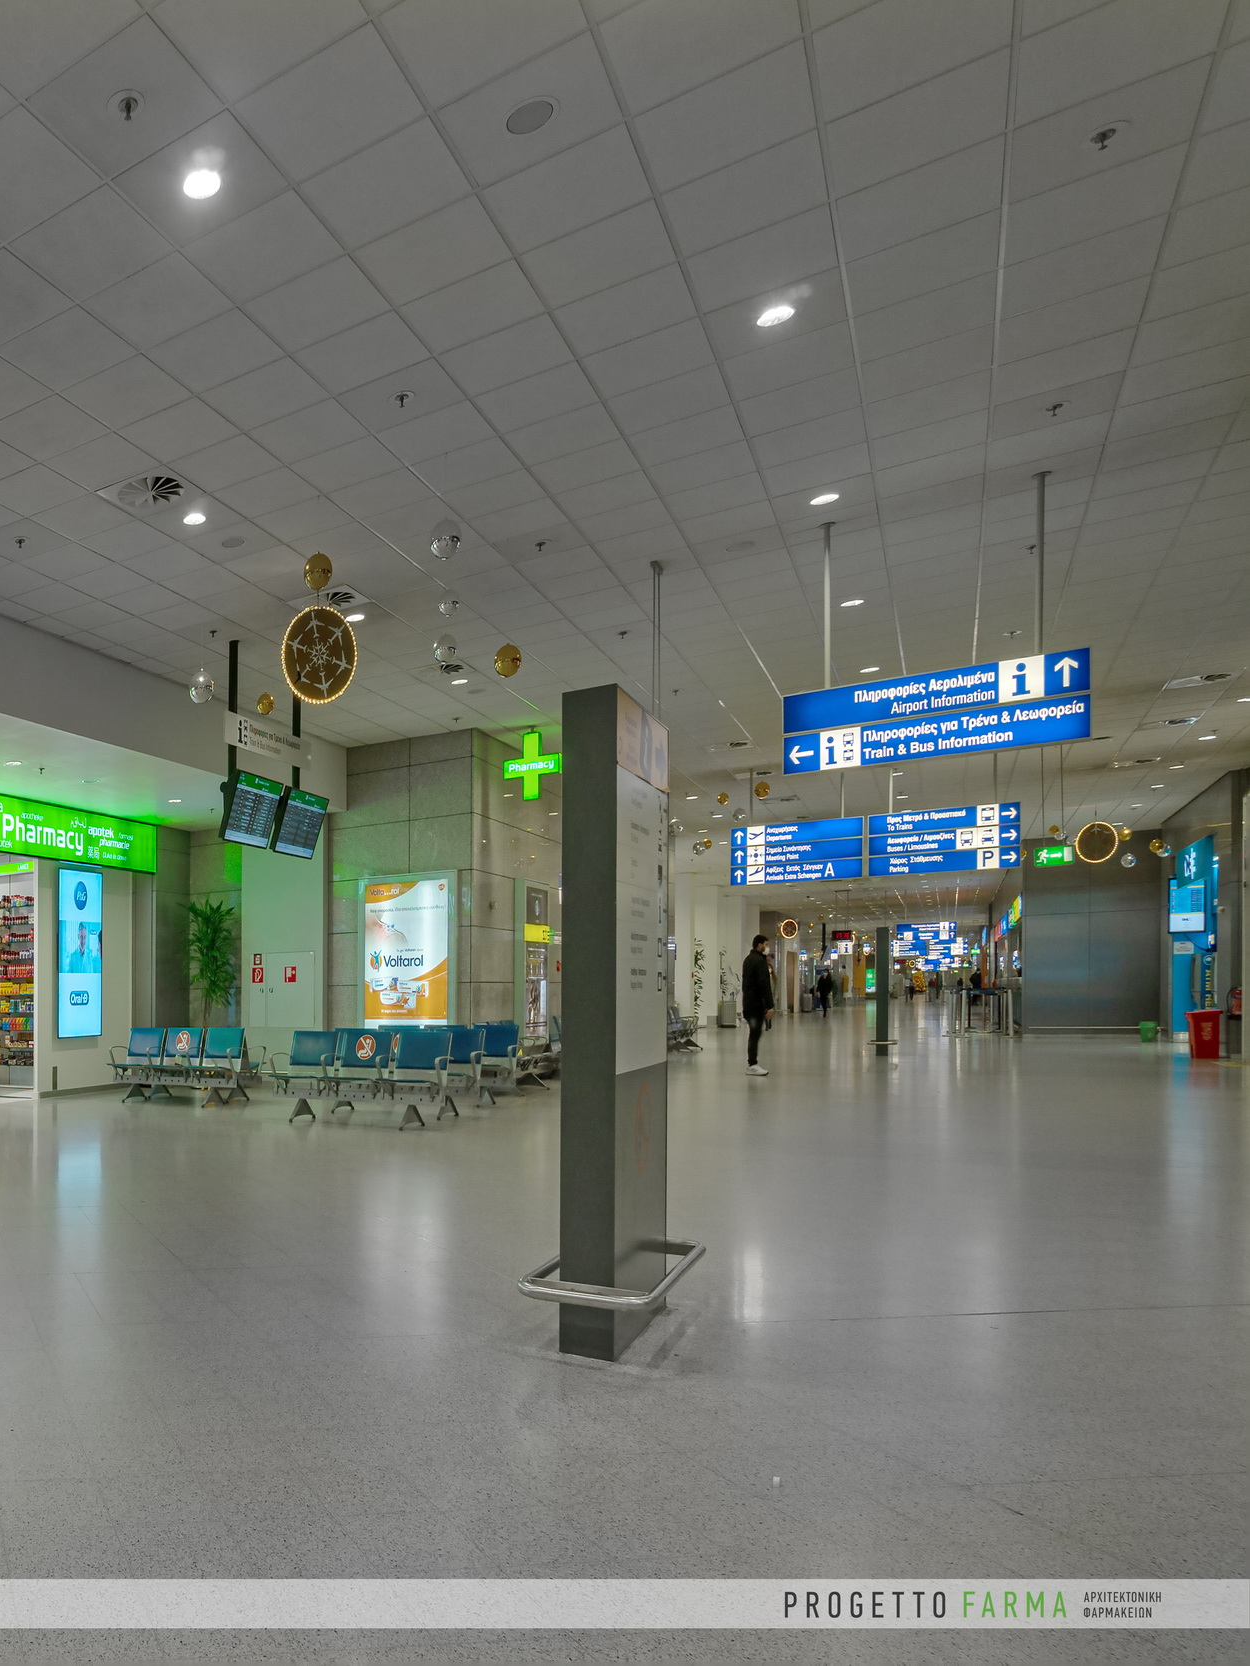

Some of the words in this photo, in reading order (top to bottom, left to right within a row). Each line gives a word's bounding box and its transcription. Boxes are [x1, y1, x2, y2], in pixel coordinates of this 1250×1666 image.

[854, 681, 926, 704] Πληροφορίες
[928, 671, 996, 692] Αερολιμένα
[891, 697, 928, 715] Airport
[930, 689, 996, 709] Information
[863, 725, 938, 745] Πληροφορίες
[940, 719, 959, 736] για
[961, 713, 999, 732] Τρένα
[1001, 711, 1011, 723] &
[1013, 700, 1085, 722] Λεωφορεία
[863, 745, 895, 760] Train
[898, 743, 907, 756] &
[910, 739, 935, 754] Bus
[937, 730, 1014, 750] Information
[508, 760, 554, 773] Pharmacy
[21, 812, 44, 821] apotheke
[887, 816, 903, 825] Προς
[903, 814, 922, 823] Μετρό
[930, 809, 966, 820] Προαστιακό
[88, 826, 114, 838] apotek
[766, 825, 799, 834] Αναχωρήσεις
[895, 823, 913, 831] Trains
[2, 813, 84, 856] Pharmacy
[766, 834, 793, 842] Departures
[887, 836, 919, 845] Λεωφορεία
[923, 832, 955, 841] Λιμουζίνες
[99, 838, 130, 850] pharmacie
[766, 846, 782, 854] Σημείο
[887, 845, 904, 853] Buses
[908, 842, 939, 851] Limousines
[766, 854, 786, 862] Meeting
[786, 852, 799, 860] Point
[889, 857, 908, 865] Χώρος
[910, 854, 944, 863] Στάθμευσης
[824, 862, 835, 877] A
[889, 865, 909, 873] Parking
[766, 873, 784, 881] Arrivals
[784, 872, 797, 880] Extra
[797, 870, 822, 879] Schengen
[383, 954, 424, 967] Voltarol
[70, 992, 89, 1004] Oral-B
